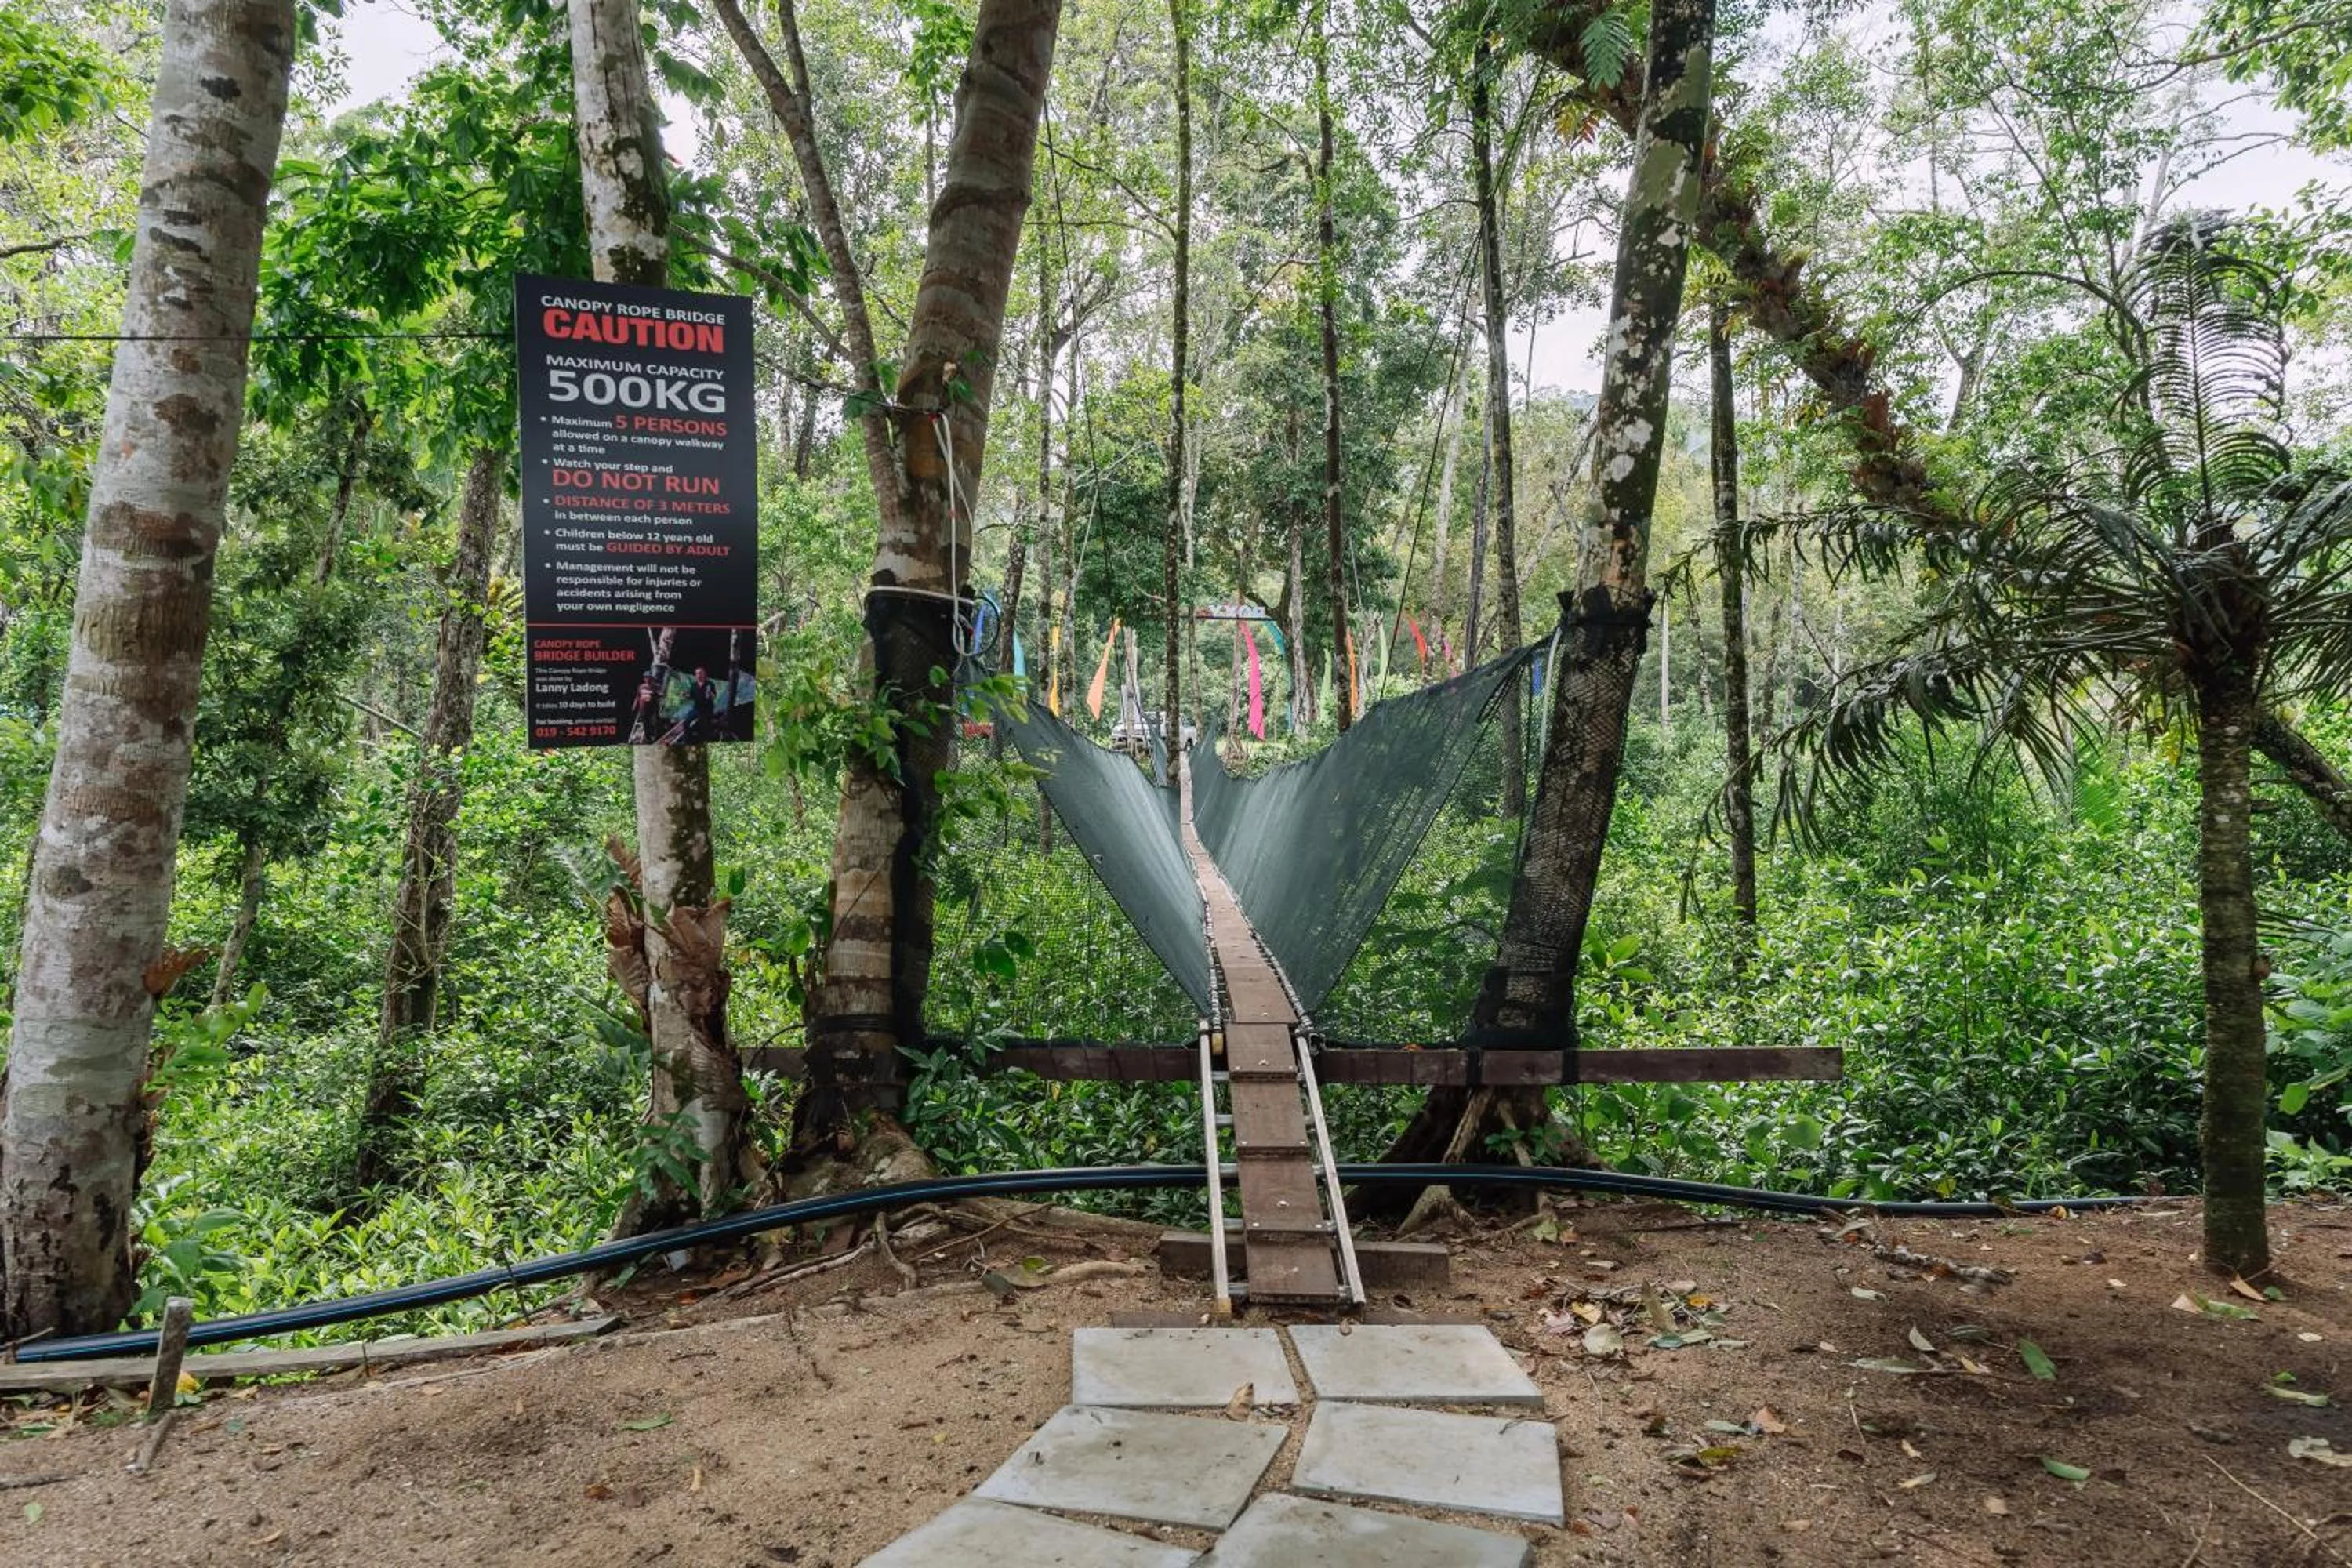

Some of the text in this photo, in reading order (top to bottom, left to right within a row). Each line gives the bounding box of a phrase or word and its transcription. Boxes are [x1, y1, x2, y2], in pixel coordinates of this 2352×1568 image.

[541, 296, 725, 325] CANOPY ROPE BRIDGE
[543, 309, 724, 353] CAUTION
[546, 354, 724, 380] MAXIMUM CAPACITY
[549, 370, 726, 413] 500KG
[551, 415, 728, 436] Maximum 5 PERSONS
[552, 429, 599, 441] allowed
[631, 436, 672, 447] canopy
[674, 438, 724, 451] walkway
[553, 443, 565, 452] at
[578, 444, 606, 454] time
[553, 457, 673, 474] Watch your step and
[553, 468, 720, 495] DO NOT RUN
[554, 495, 731, 514] DISTANCE OF 3 METERS
[568, 511, 621, 522] between
[623, 514, 651, 523] each
[654, 516, 692, 526] person
[554, 528, 713, 543] Children below 12 years old
[555, 542, 730, 556] must be GUIDED BY ADULT
[556, 561, 696, 575] Management will not be
[556, 575, 623, 586] responsible
[626, 576, 643, 586] for
[645, 576, 687, 587] injuries
[556, 589, 682, 601] accidents arising from
[556, 603, 585, 612] your
[615, 601, 675, 614] negligence
[534, 639, 573, 649] CANOPY
[534, 650, 636, 661] BRIDGE BUILDER
[535, 682, 609, 695] Lanny Ladong
